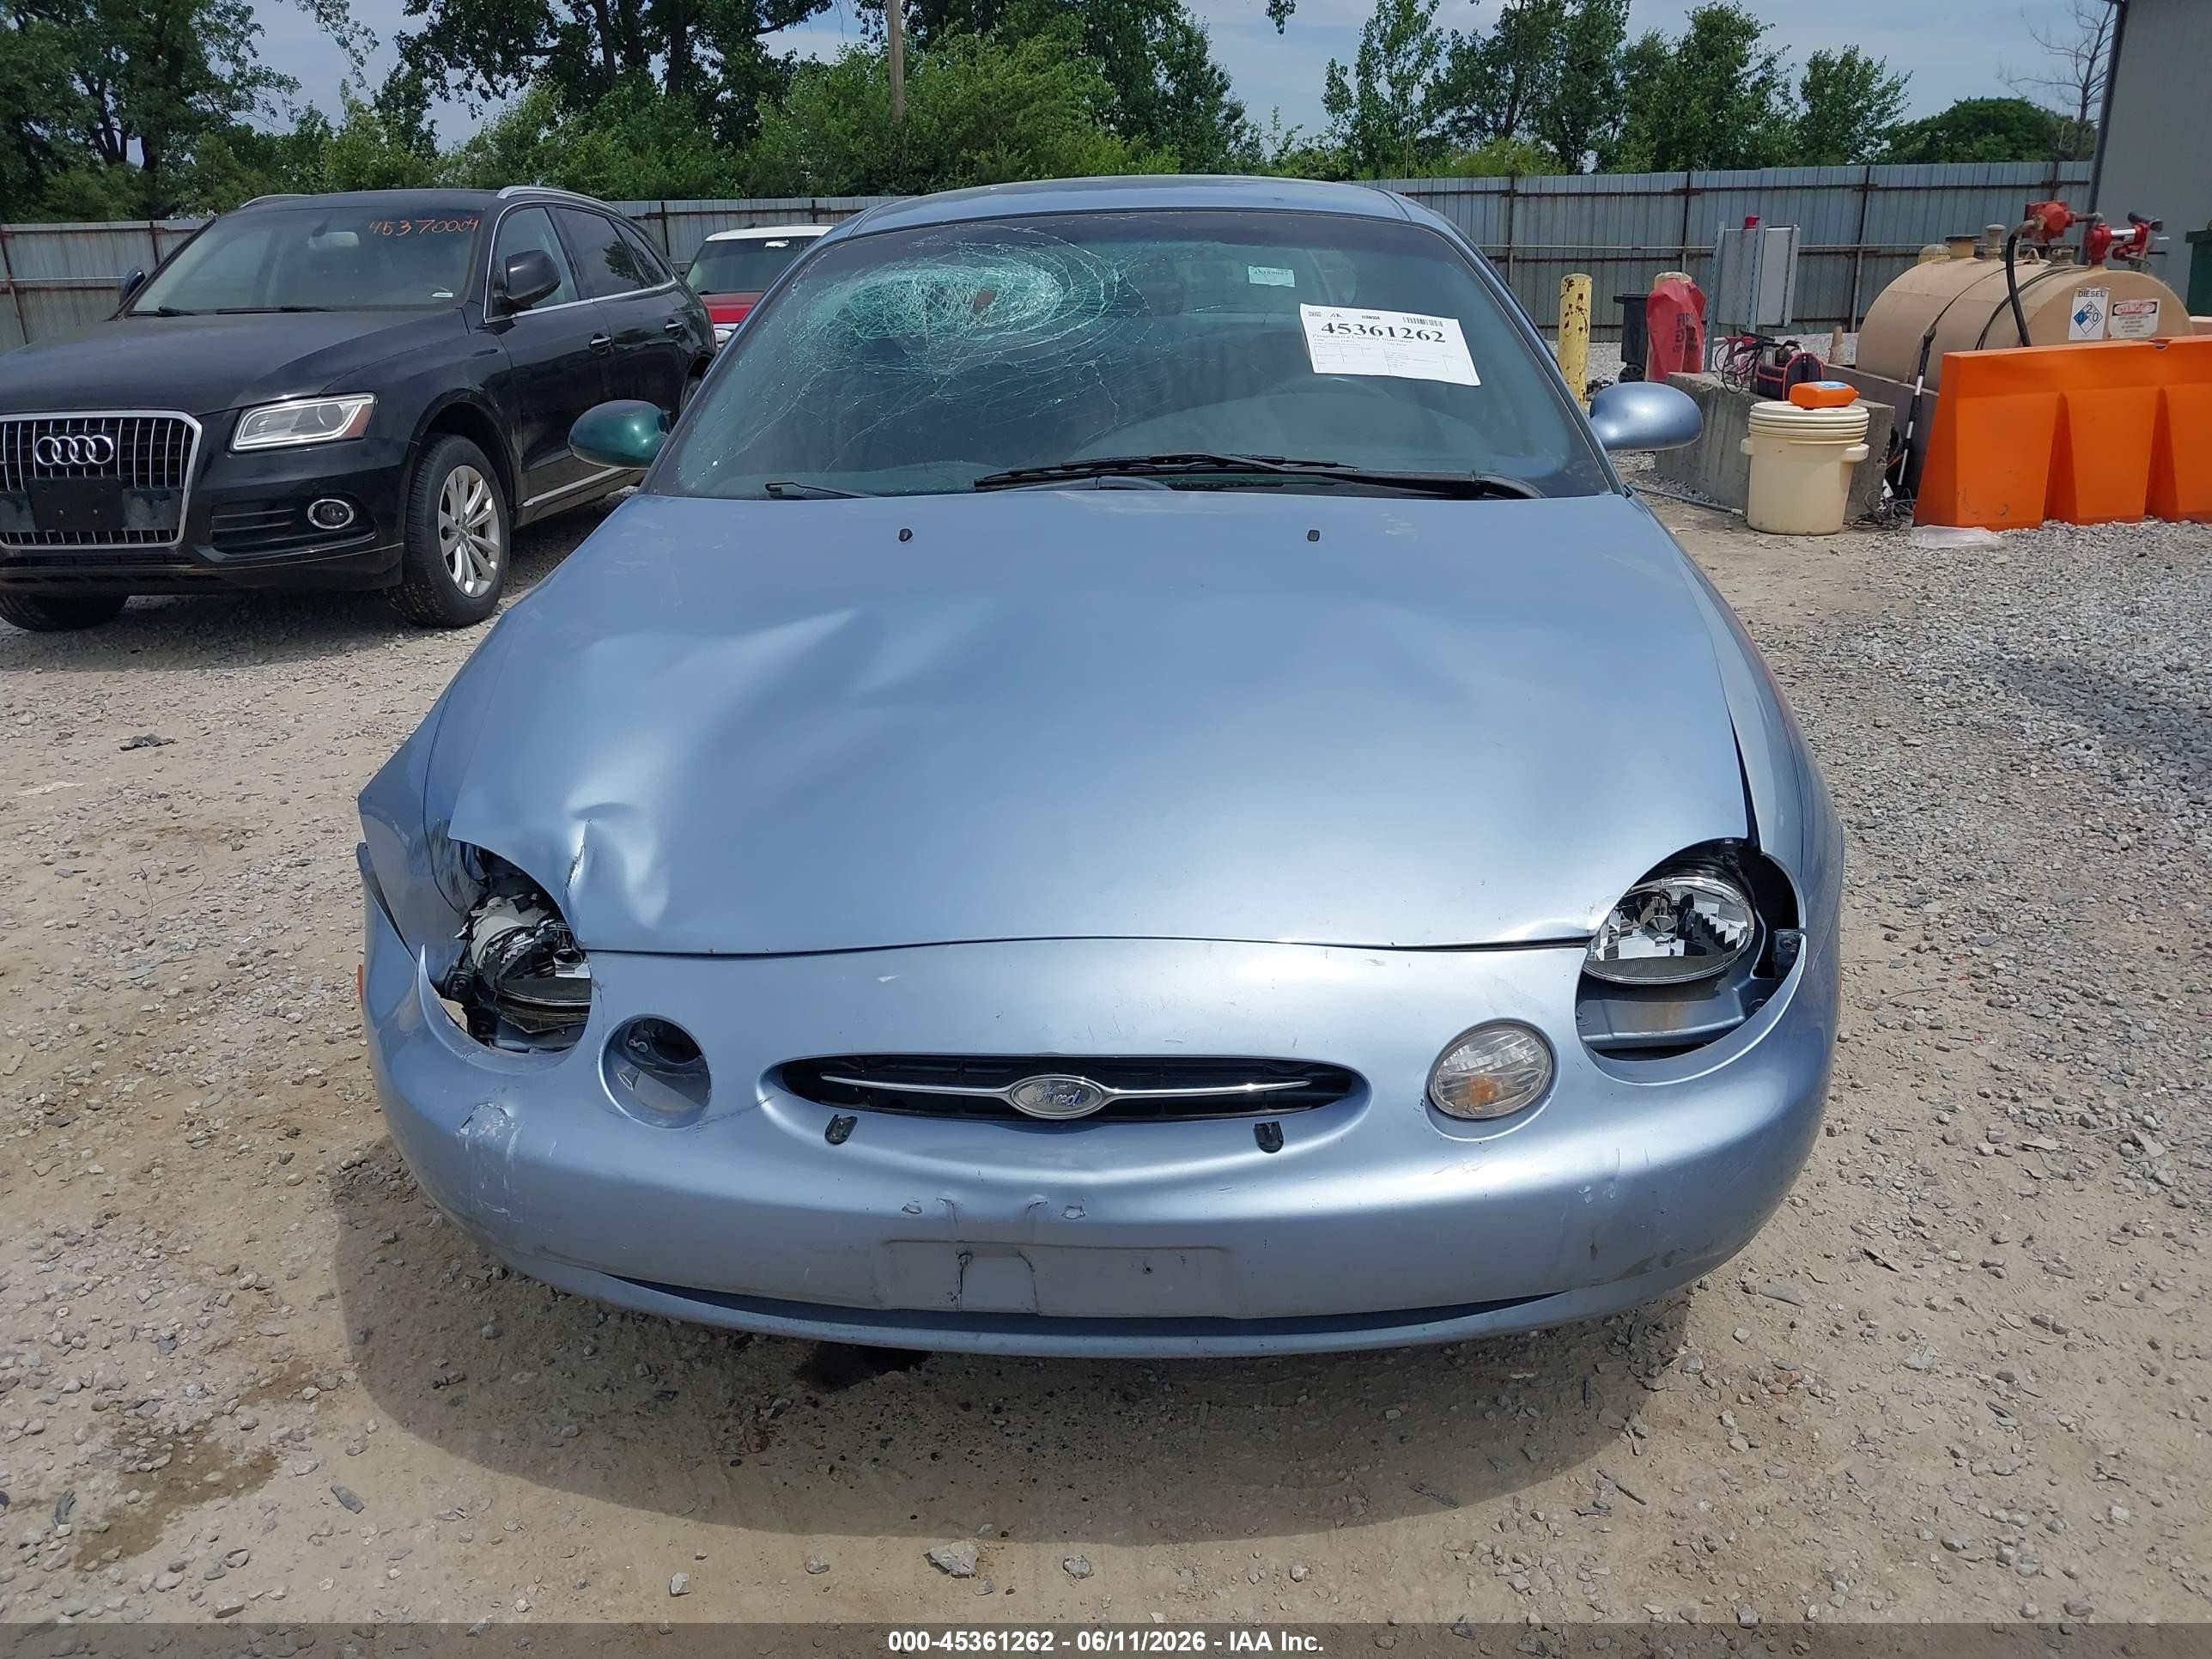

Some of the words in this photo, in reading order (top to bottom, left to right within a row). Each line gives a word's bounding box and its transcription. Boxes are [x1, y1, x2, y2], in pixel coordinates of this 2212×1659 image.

[2086, 304, 2094, 314] 2
[2092, 312, 2100, 322] 0
[1321, 321, 1447, 343] 45361262
[1032, 1084, 1081, 1107] Ford
